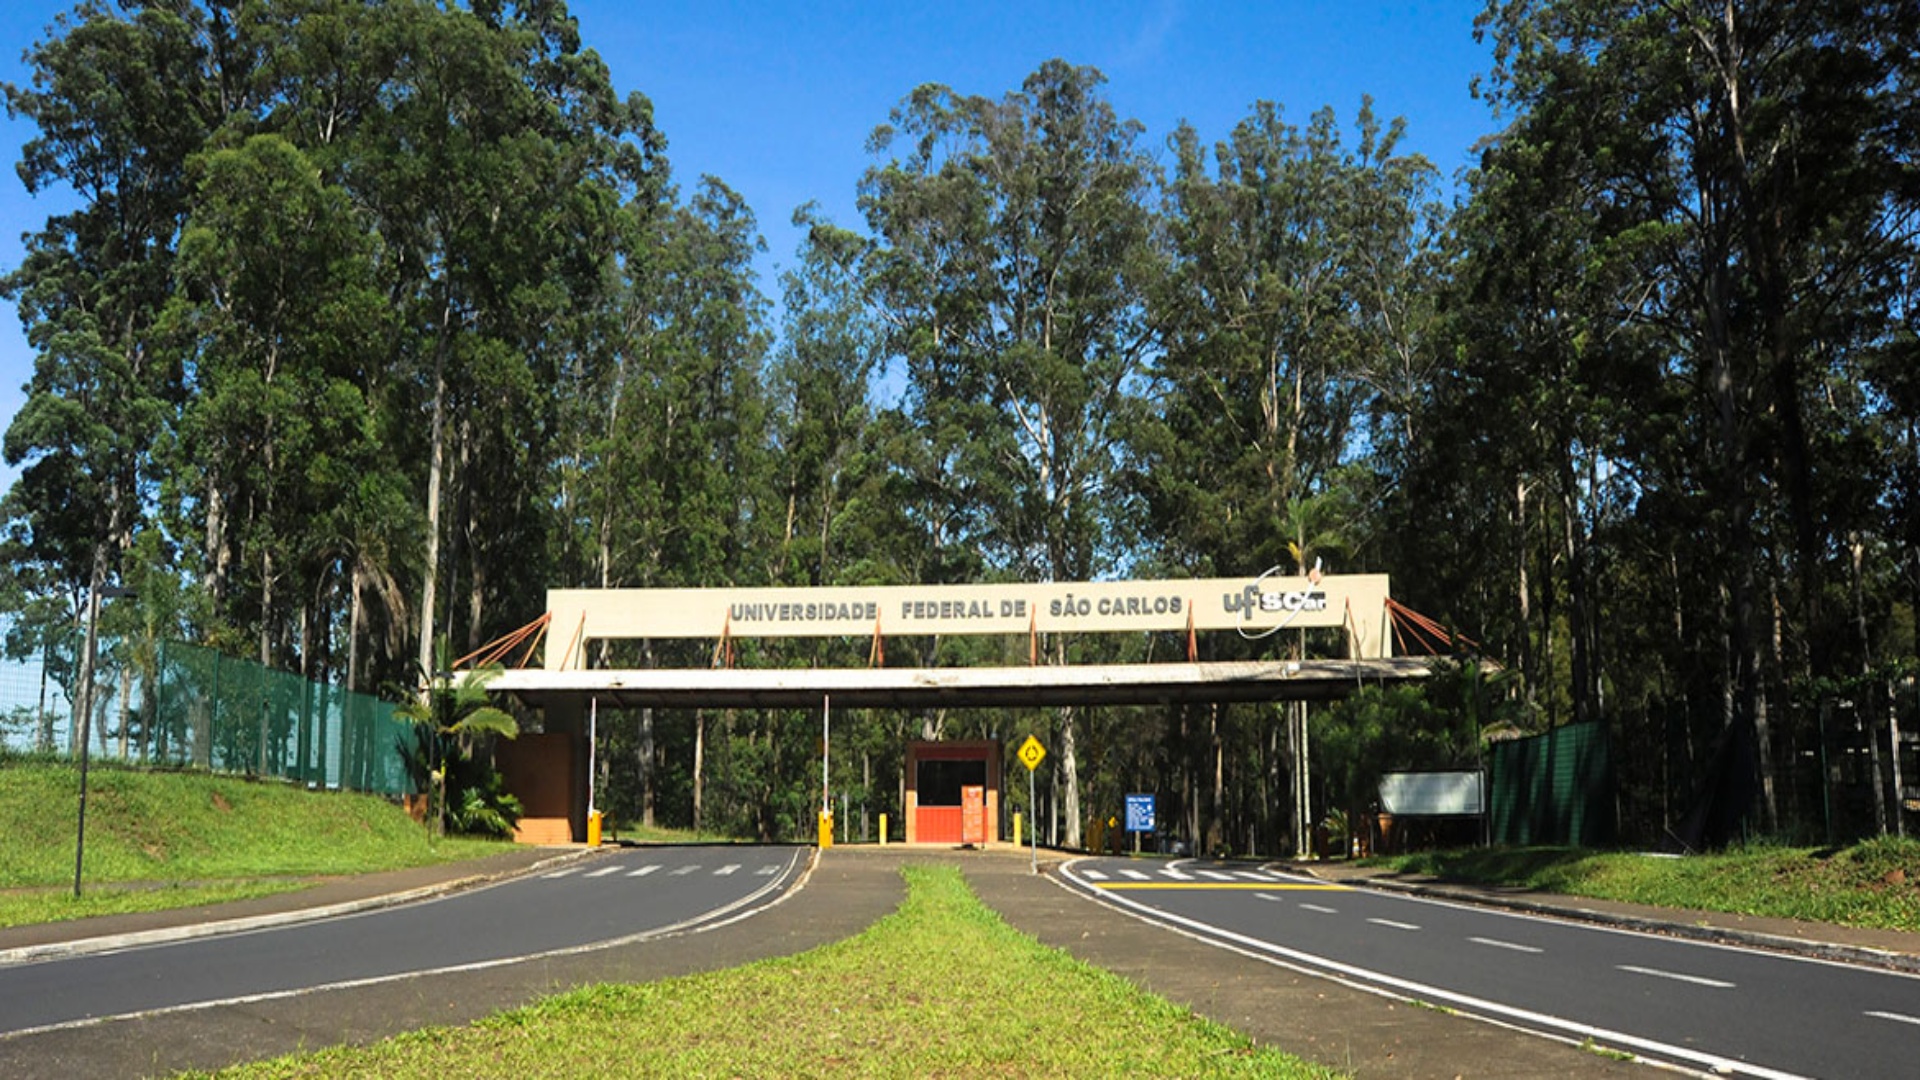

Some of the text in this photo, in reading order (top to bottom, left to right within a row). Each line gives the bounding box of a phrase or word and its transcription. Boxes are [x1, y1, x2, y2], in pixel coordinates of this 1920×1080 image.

[731, 593, 1183, 622] UNIVERSIDADE FEDERAL DE SÃO CARLOS
